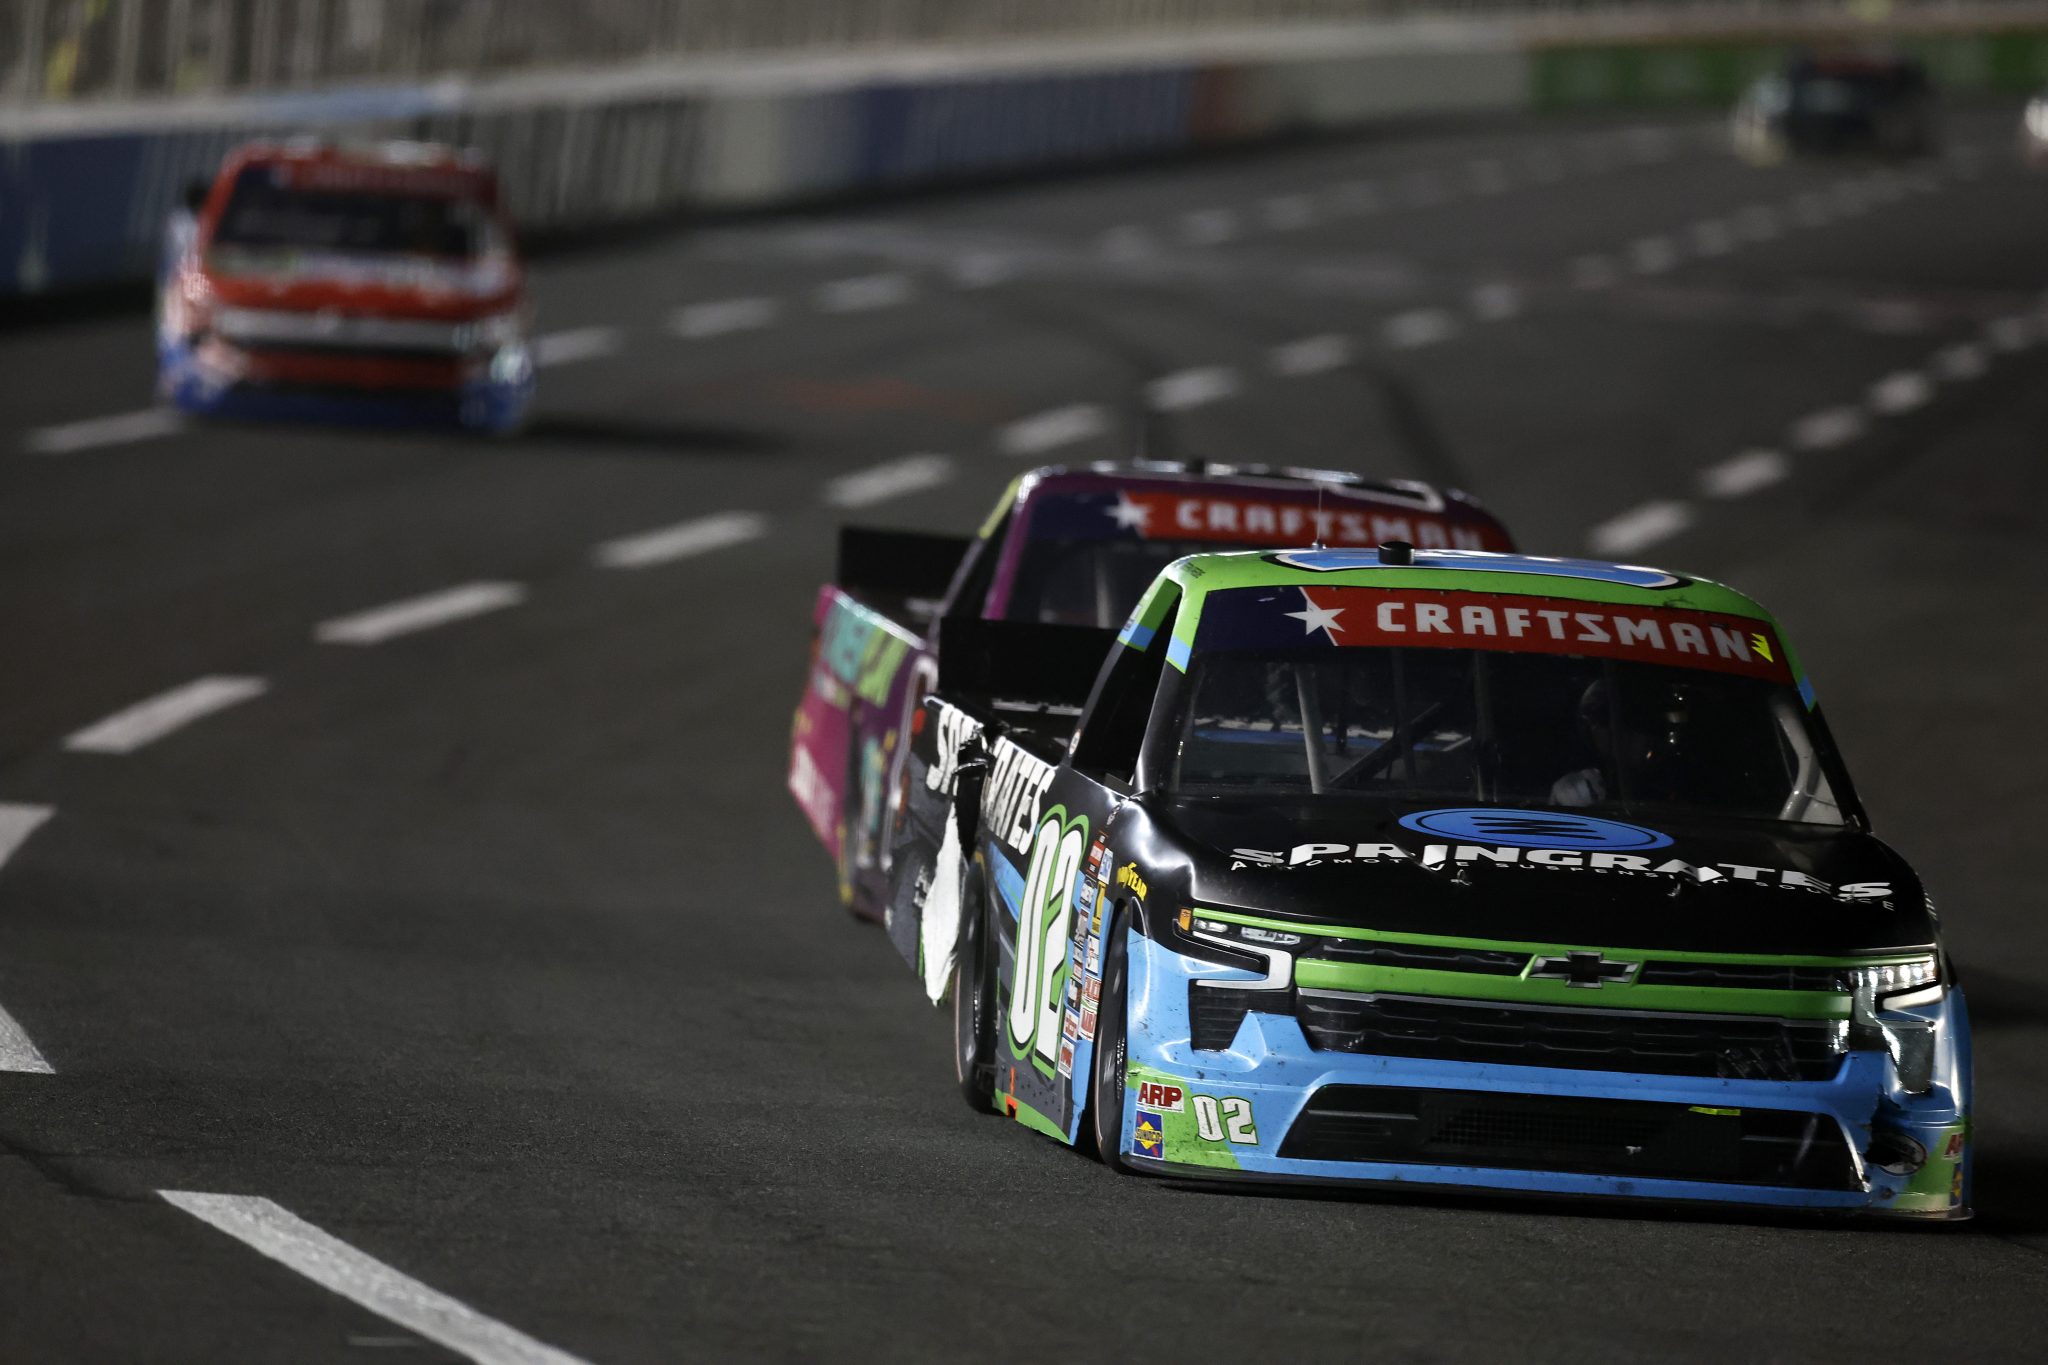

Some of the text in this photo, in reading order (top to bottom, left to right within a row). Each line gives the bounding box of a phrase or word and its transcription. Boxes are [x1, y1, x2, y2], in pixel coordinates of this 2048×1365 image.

[1175, 500, 1483, 551] CRAFTSMAN
[1376, 601, 1754, 662] CRAFTSMAN
[1229, 843, 1894, 898] SPRINGRATES
[1230, 858, 1470, 872] AUTOMOTVE
[1495, 862, 1729, 886] SUSPENSIN
[1009, 814, 1087, 1068] 02
[1138, 1082, 1183, 1107] ARP
[1191, 1094, 1258, 1145] 02
